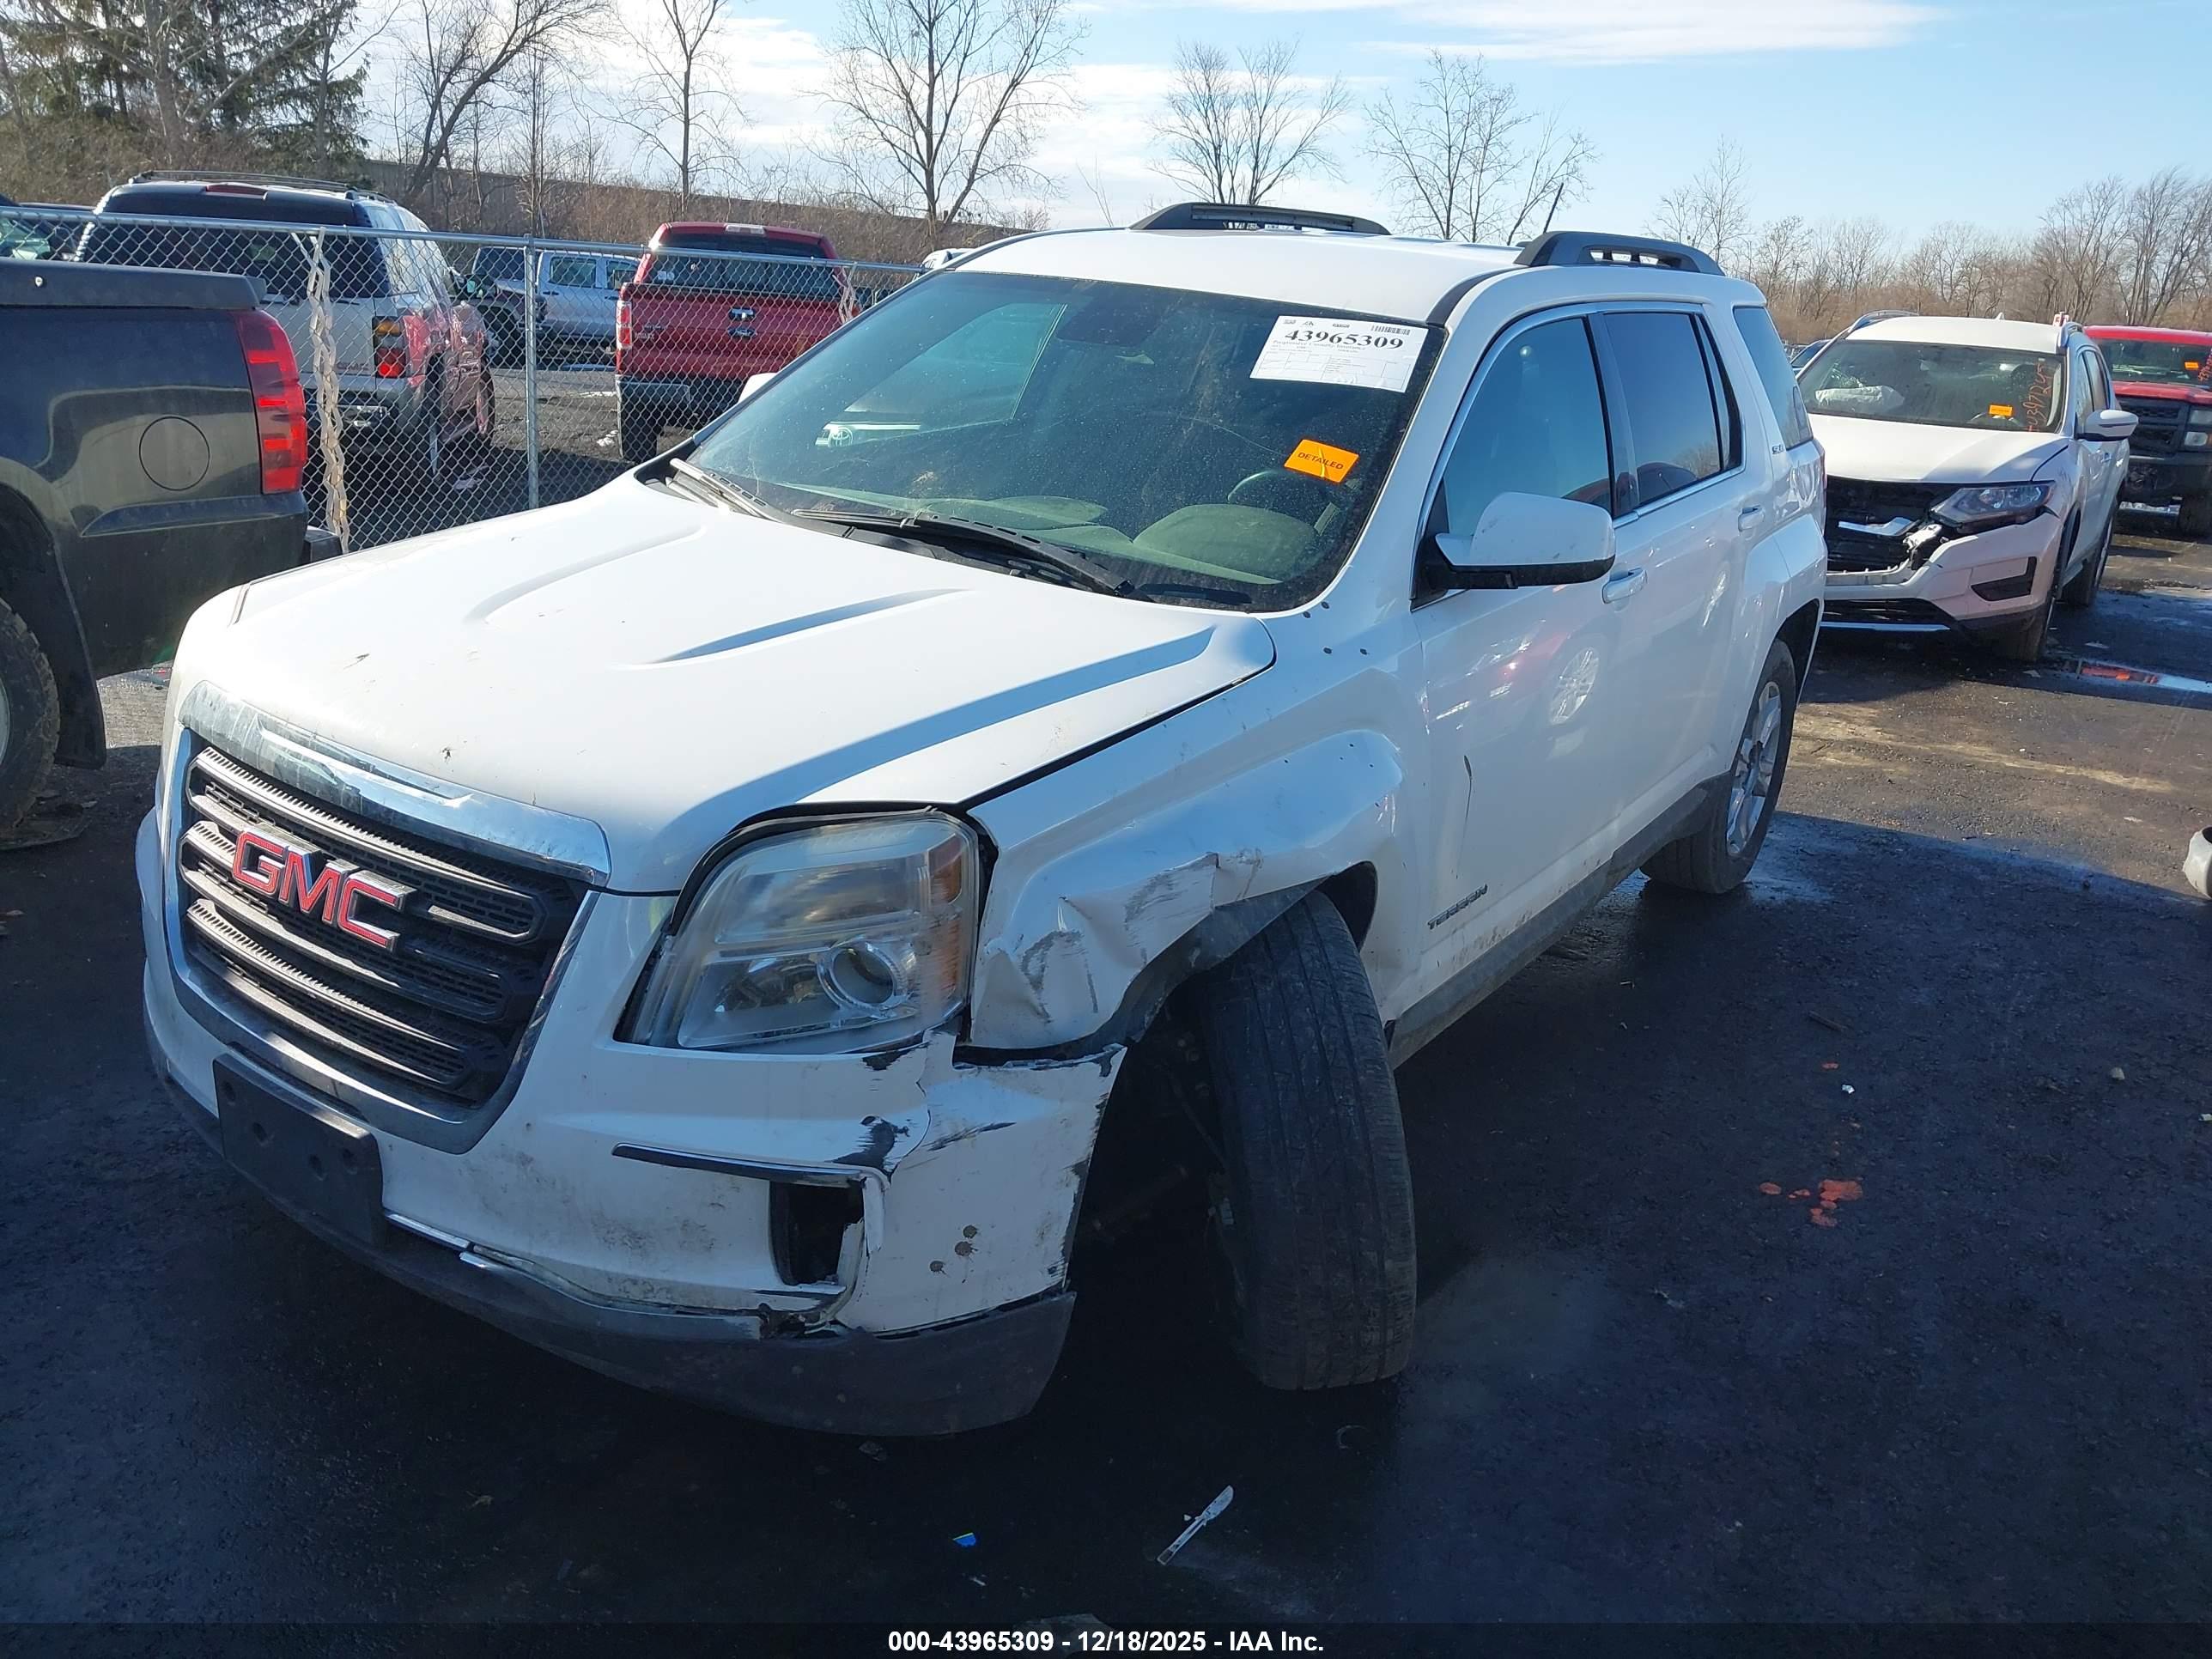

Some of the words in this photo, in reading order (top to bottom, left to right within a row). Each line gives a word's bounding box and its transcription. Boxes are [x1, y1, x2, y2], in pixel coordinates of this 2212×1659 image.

[1285, 329, 1404, 349] 43965309
[1297, 452, 1344, 470] DETAILED
[233, 830, 402, 950] GMC
